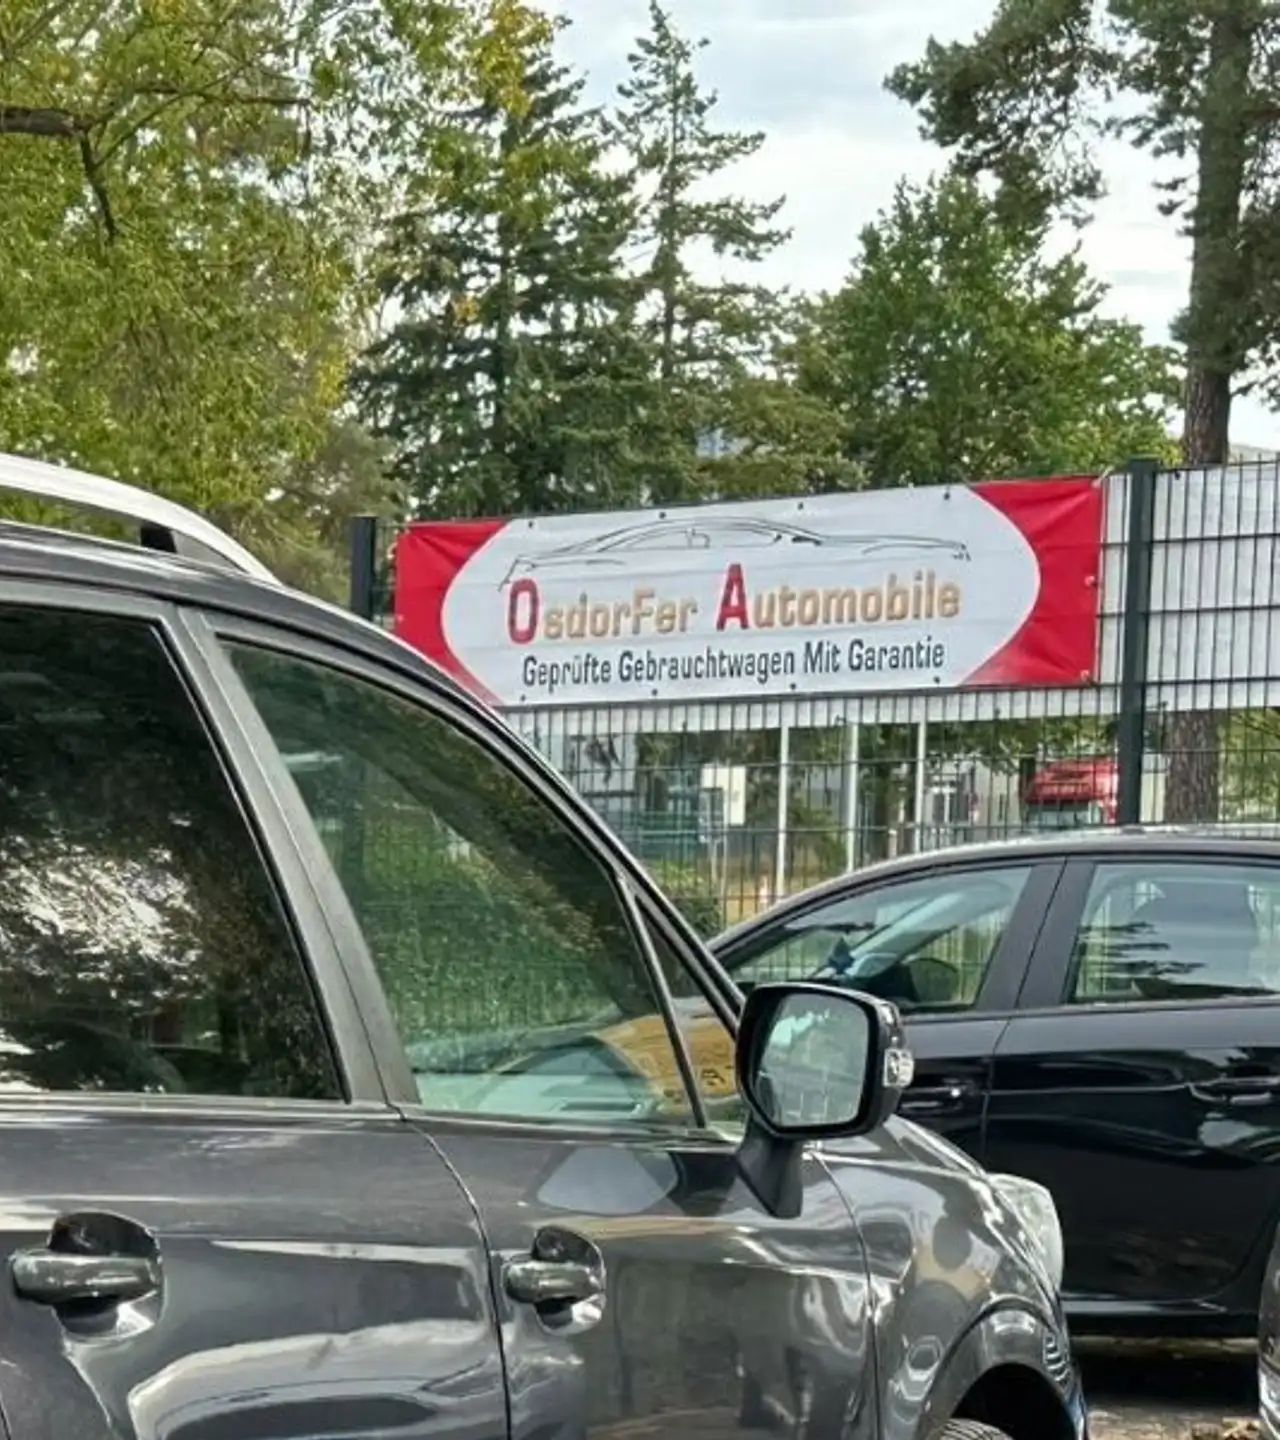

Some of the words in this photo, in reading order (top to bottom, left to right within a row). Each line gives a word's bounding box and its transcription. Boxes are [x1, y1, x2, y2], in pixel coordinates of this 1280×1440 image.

[507, 578, 698, 644] OsdorFer
[715, 563, 961, 632] Automobile
[523, 652, 612, 694] Geprüfte
[618, 645, 795, 686] Gebrauchtwagen
[803, 640, 840, 674] Mit
[848, 635, 944, 672] Garantie
